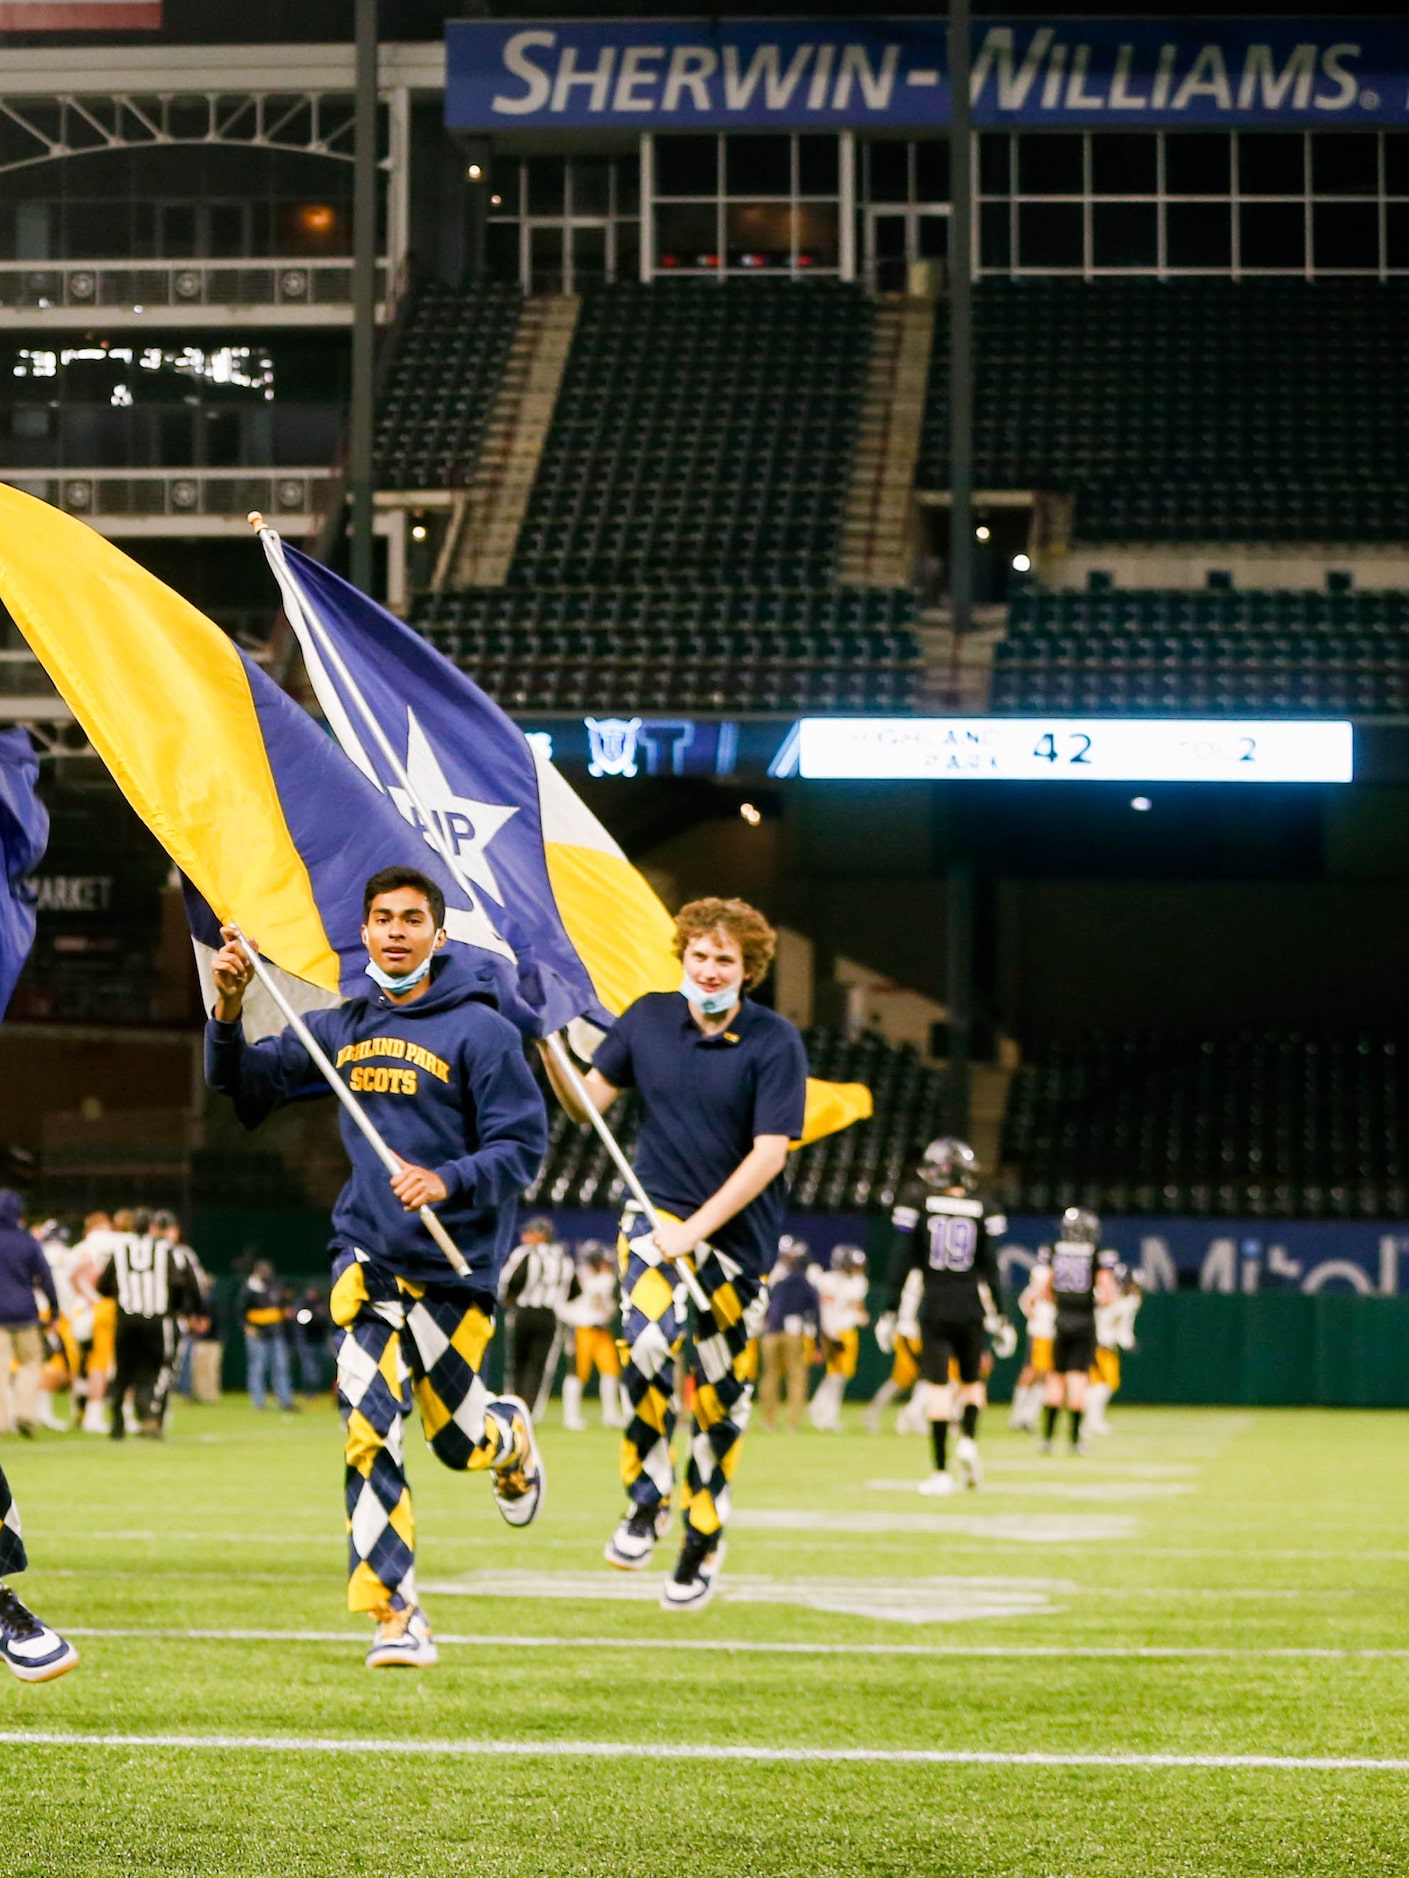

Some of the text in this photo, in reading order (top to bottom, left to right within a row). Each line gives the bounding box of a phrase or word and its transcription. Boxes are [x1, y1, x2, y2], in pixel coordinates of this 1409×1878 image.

[1033, 732, 1092, 763] 42
[1238, 737, 1256, 761] 2
[404, 1041, 451, 1084] PARK
[349, 1066, 418, 1096] SCOTS
[926, 1214, 978, 1272] 19
